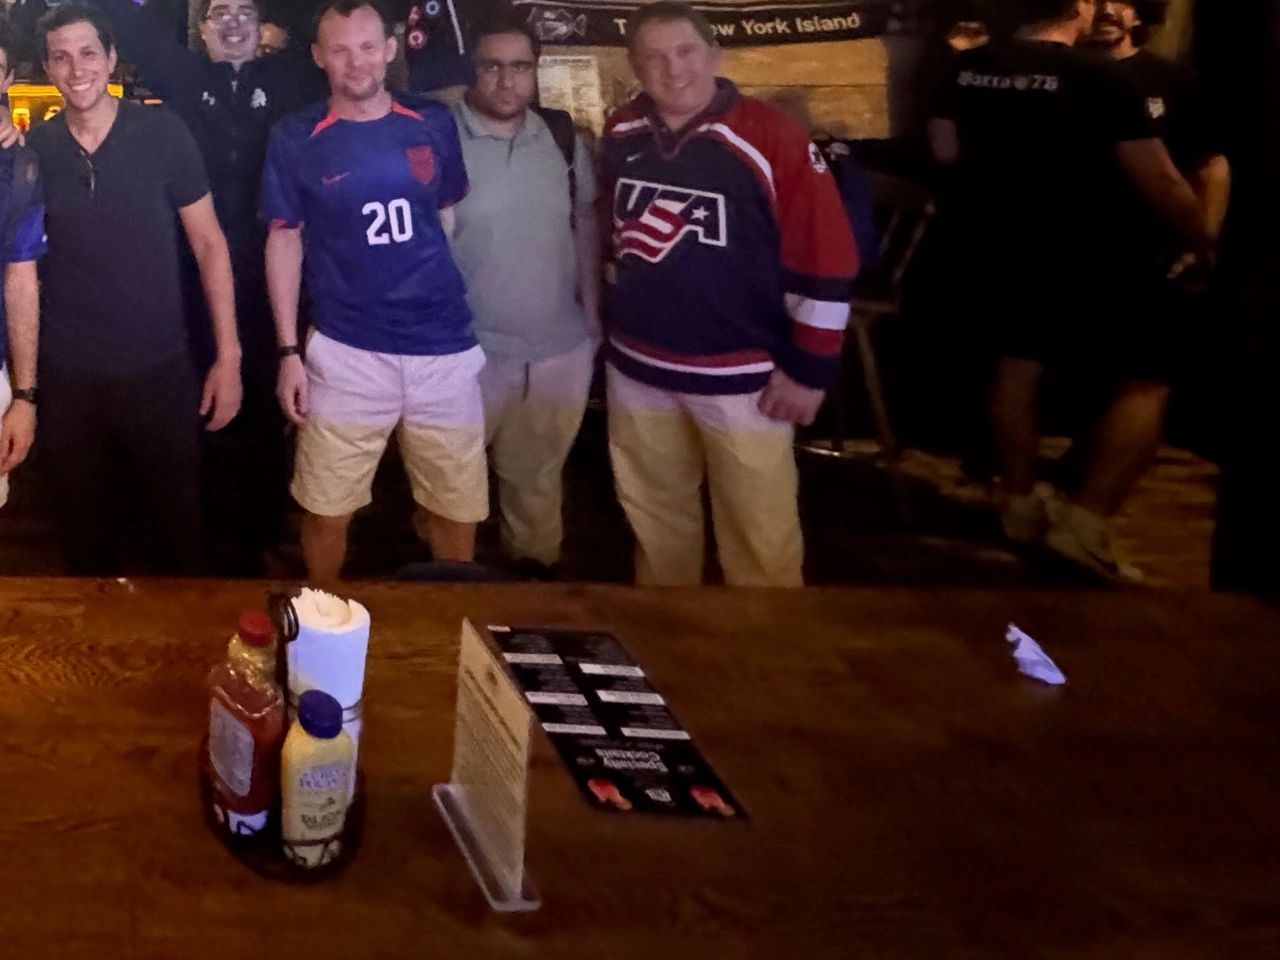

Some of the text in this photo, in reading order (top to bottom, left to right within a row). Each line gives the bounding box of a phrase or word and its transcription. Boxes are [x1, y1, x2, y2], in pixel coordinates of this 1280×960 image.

[741, 18, 791, 36] York
[795, 12, 862, 34] Island
[362, 198, 413, 246] 20
